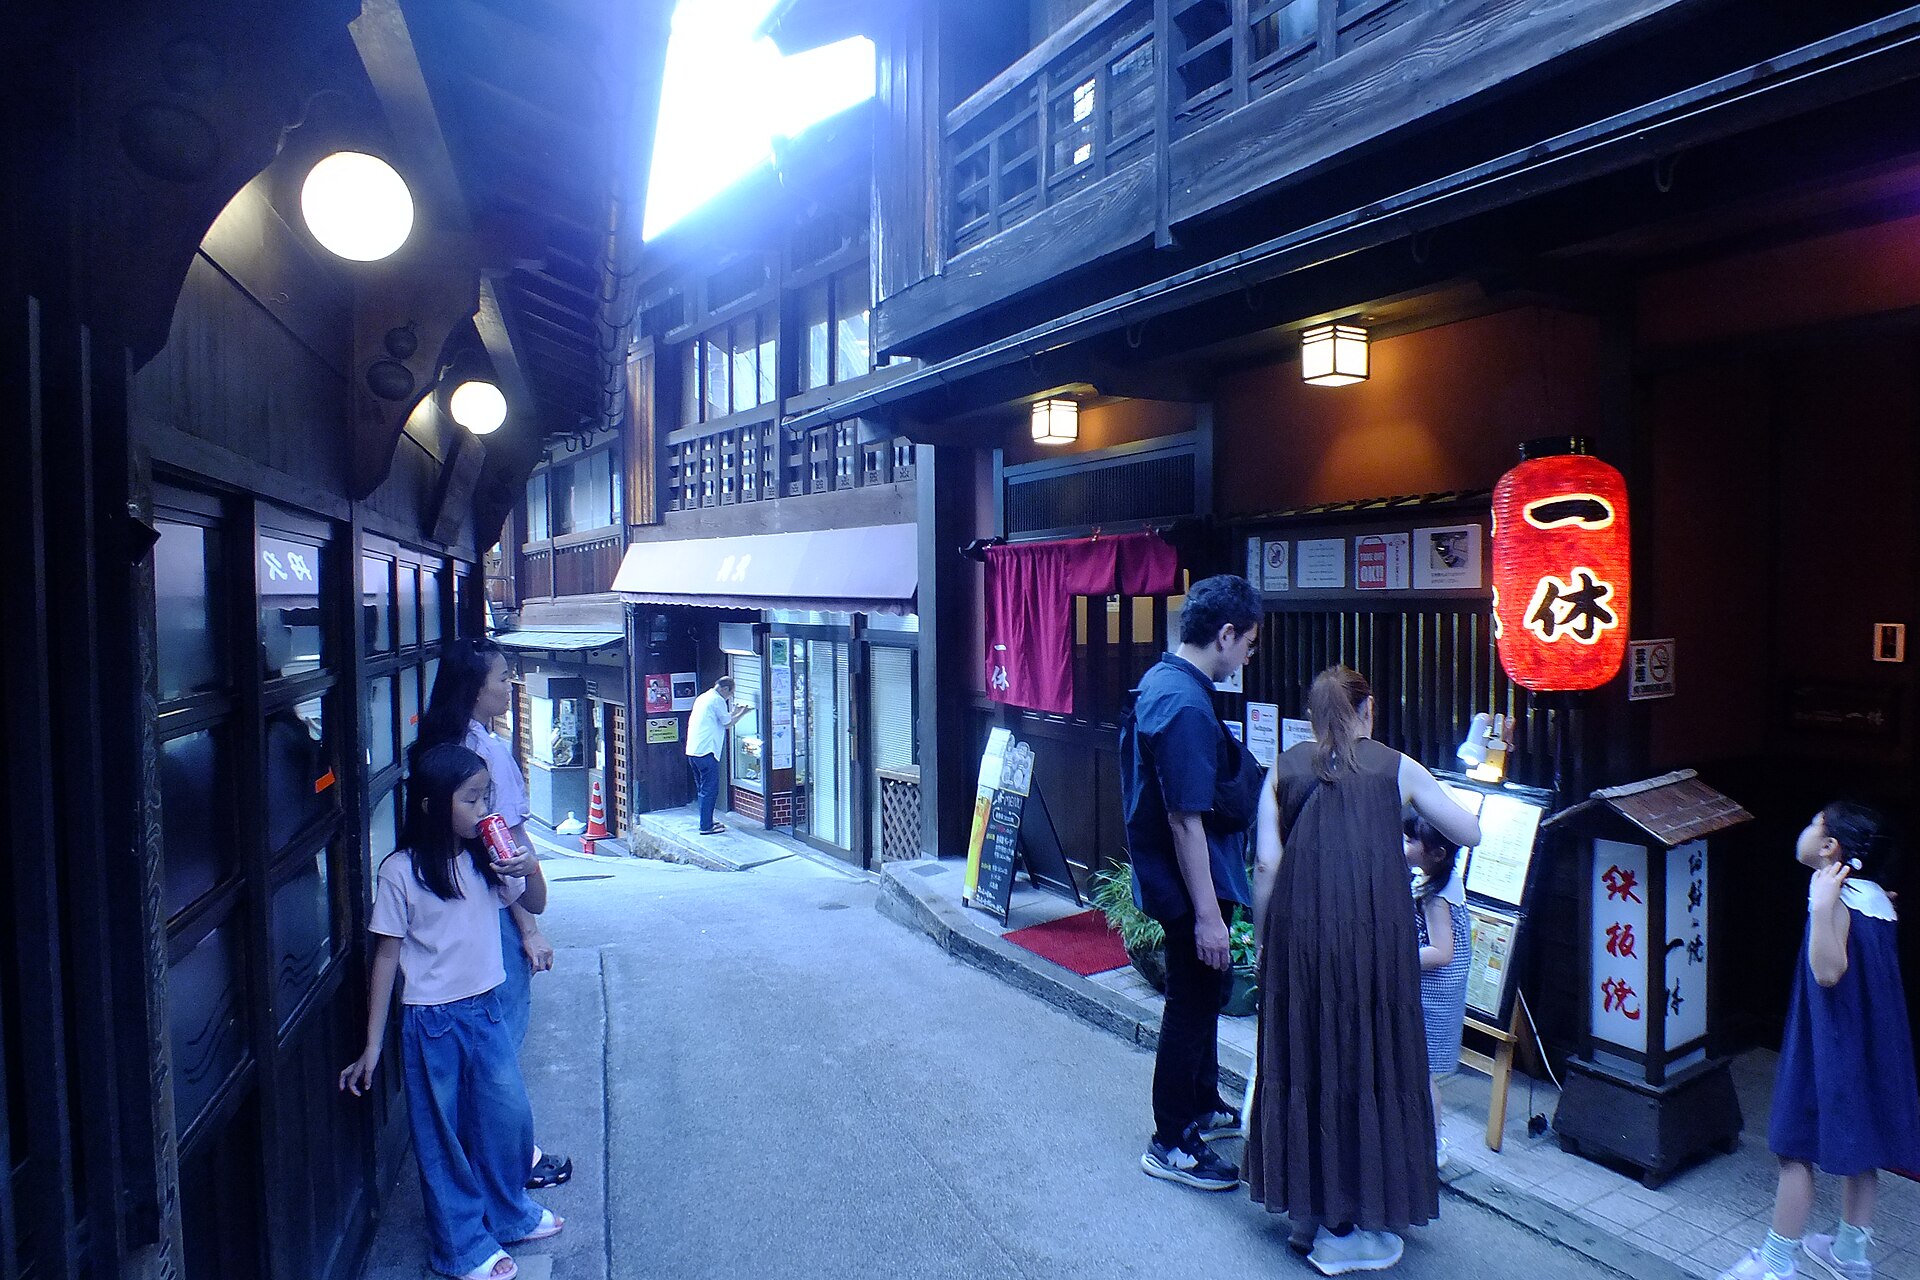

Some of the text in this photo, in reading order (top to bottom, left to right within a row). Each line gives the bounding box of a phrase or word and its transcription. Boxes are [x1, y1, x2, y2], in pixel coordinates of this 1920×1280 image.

[1523, 494, 1618, 645] 一休
[992, 644, 1010, 691] 一休
[1601, 864, 1643, 1021] 鉄板焼
